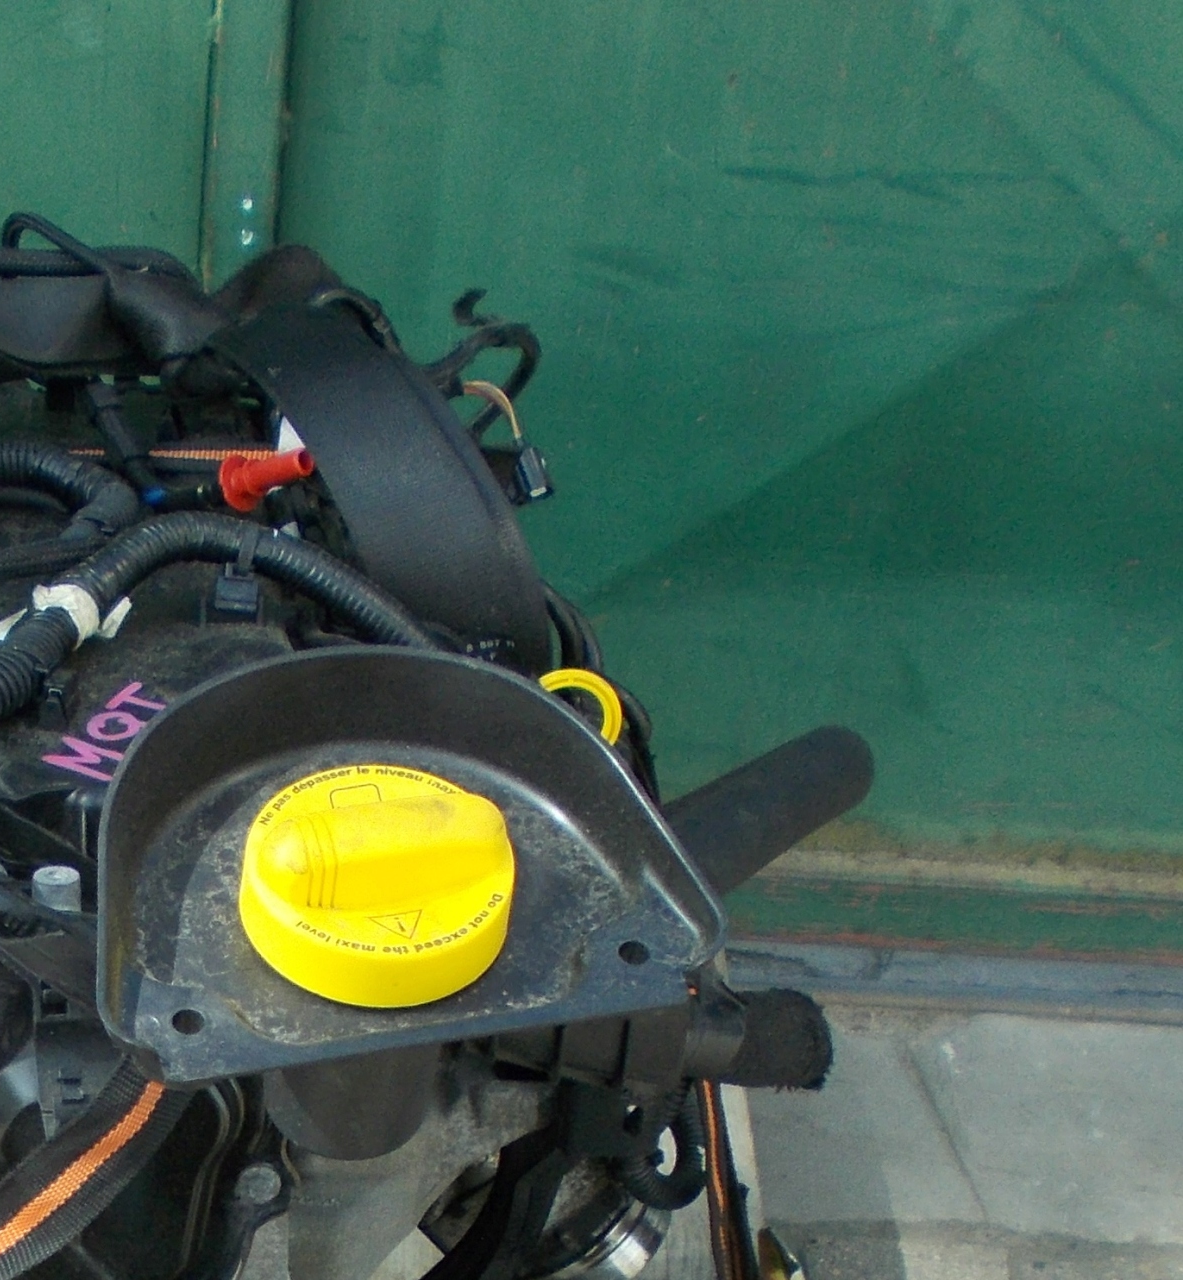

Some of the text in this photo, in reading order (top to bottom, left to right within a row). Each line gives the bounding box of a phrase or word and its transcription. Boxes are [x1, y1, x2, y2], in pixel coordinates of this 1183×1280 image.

[260, 809, 275, 826] Ne
[272, 793, 292, 812] pas
[291, 767, 352, 794] dépasser
[356, 766, 369, 775] le
[375, 766, 424, 783] niveau
[296, 893, 504, 955] Do not exceed the maxi level
